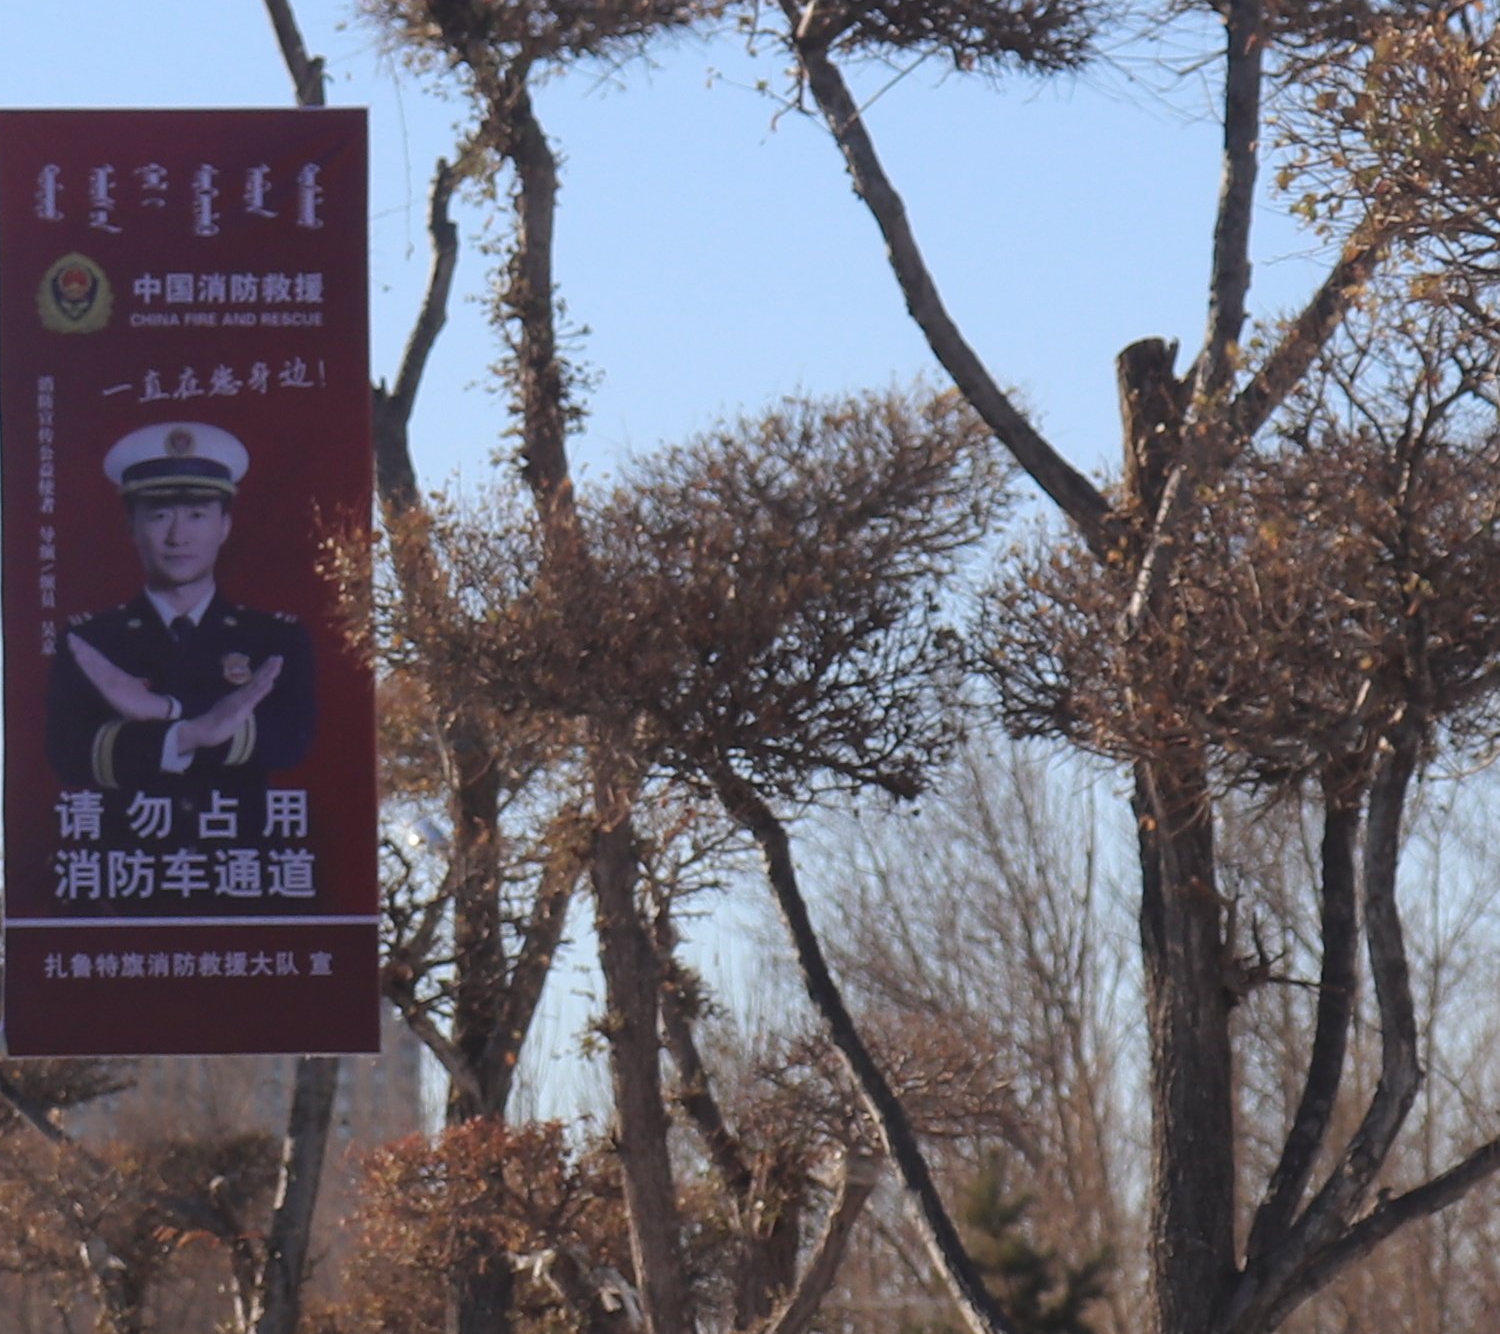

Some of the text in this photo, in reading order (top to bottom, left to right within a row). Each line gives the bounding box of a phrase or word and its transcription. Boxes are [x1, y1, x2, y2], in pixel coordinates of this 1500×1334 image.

[132, 272, 325, 304] 中国消防救援
[130, 311, 325, 327] CHINA FIRE AND RESCUE
[54, 788, 309, 841] 请勿占用
[54, 847, 317, 900] 消防车通道
[43, 951, 301, 979] 扎鲁特旗消防救援大队
